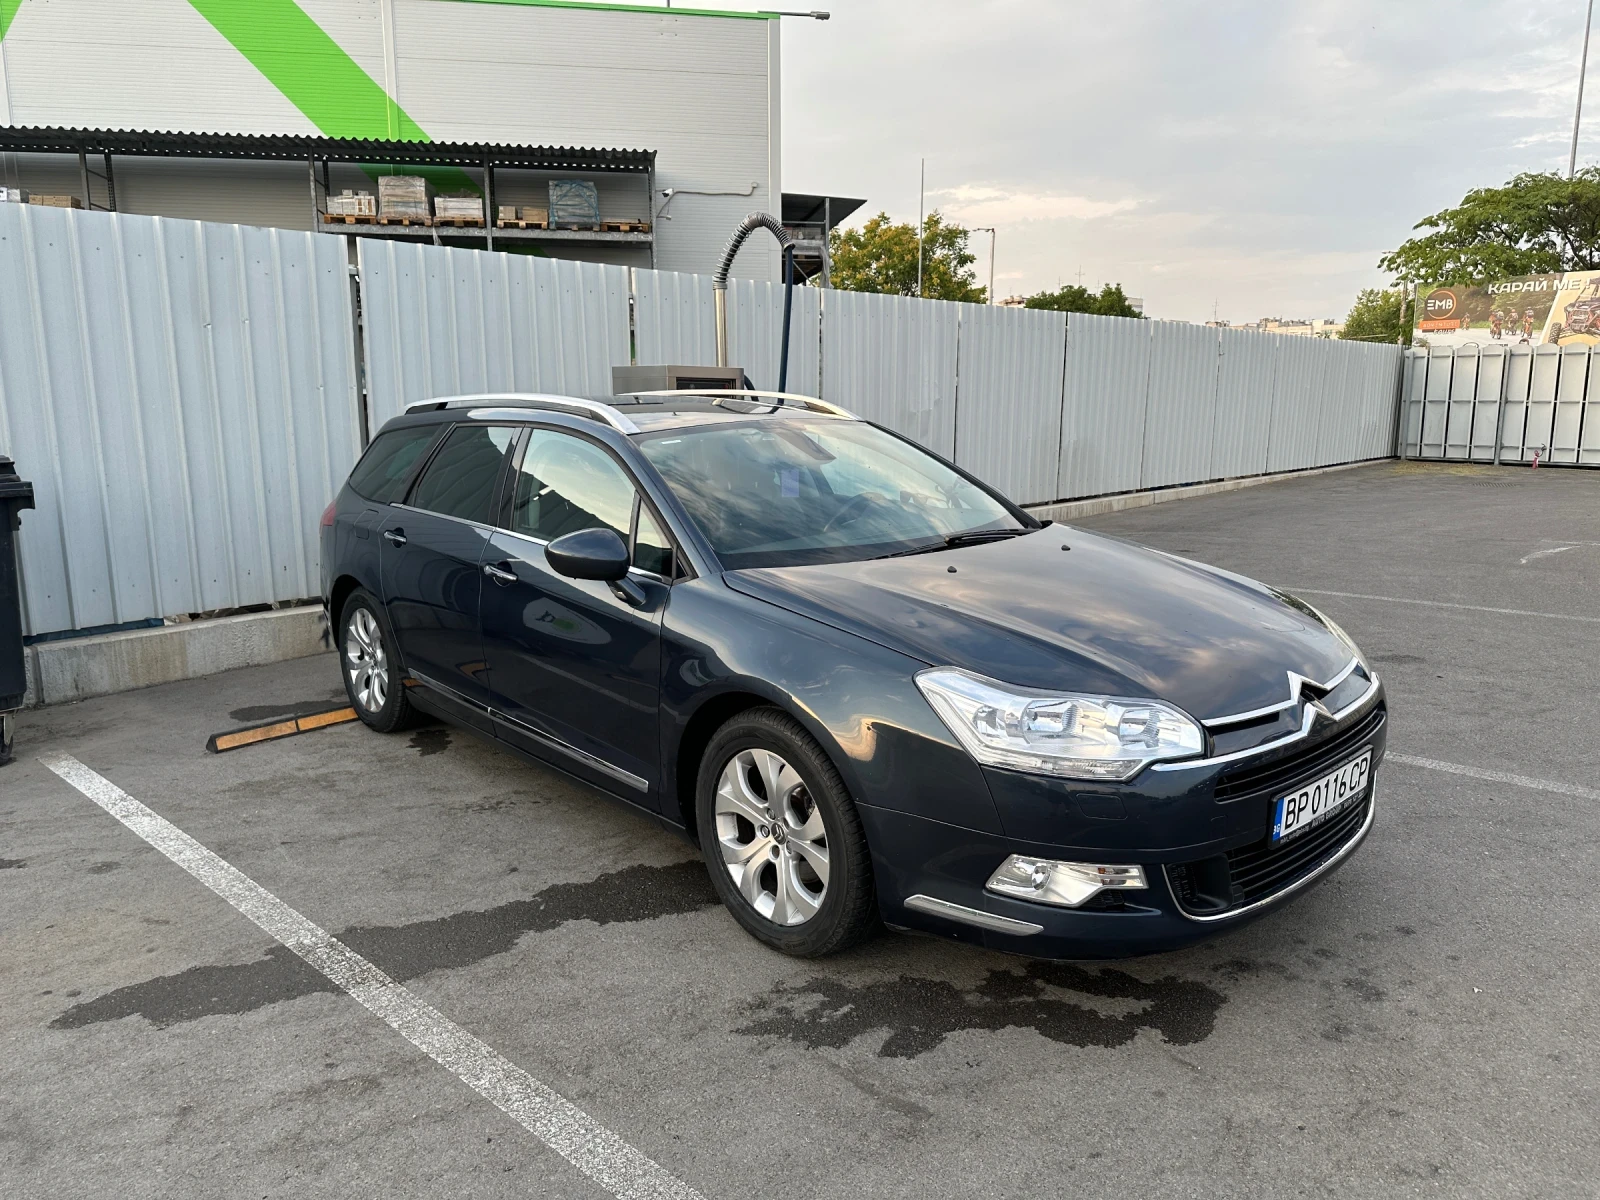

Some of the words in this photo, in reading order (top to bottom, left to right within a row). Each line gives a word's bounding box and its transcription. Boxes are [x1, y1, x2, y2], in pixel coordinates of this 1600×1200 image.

[1488, 277, 1547, 295] КАРАЙ
[1553, 279, 1581, 291] МЕ
[1427, 299, 1453, 311] EMB
